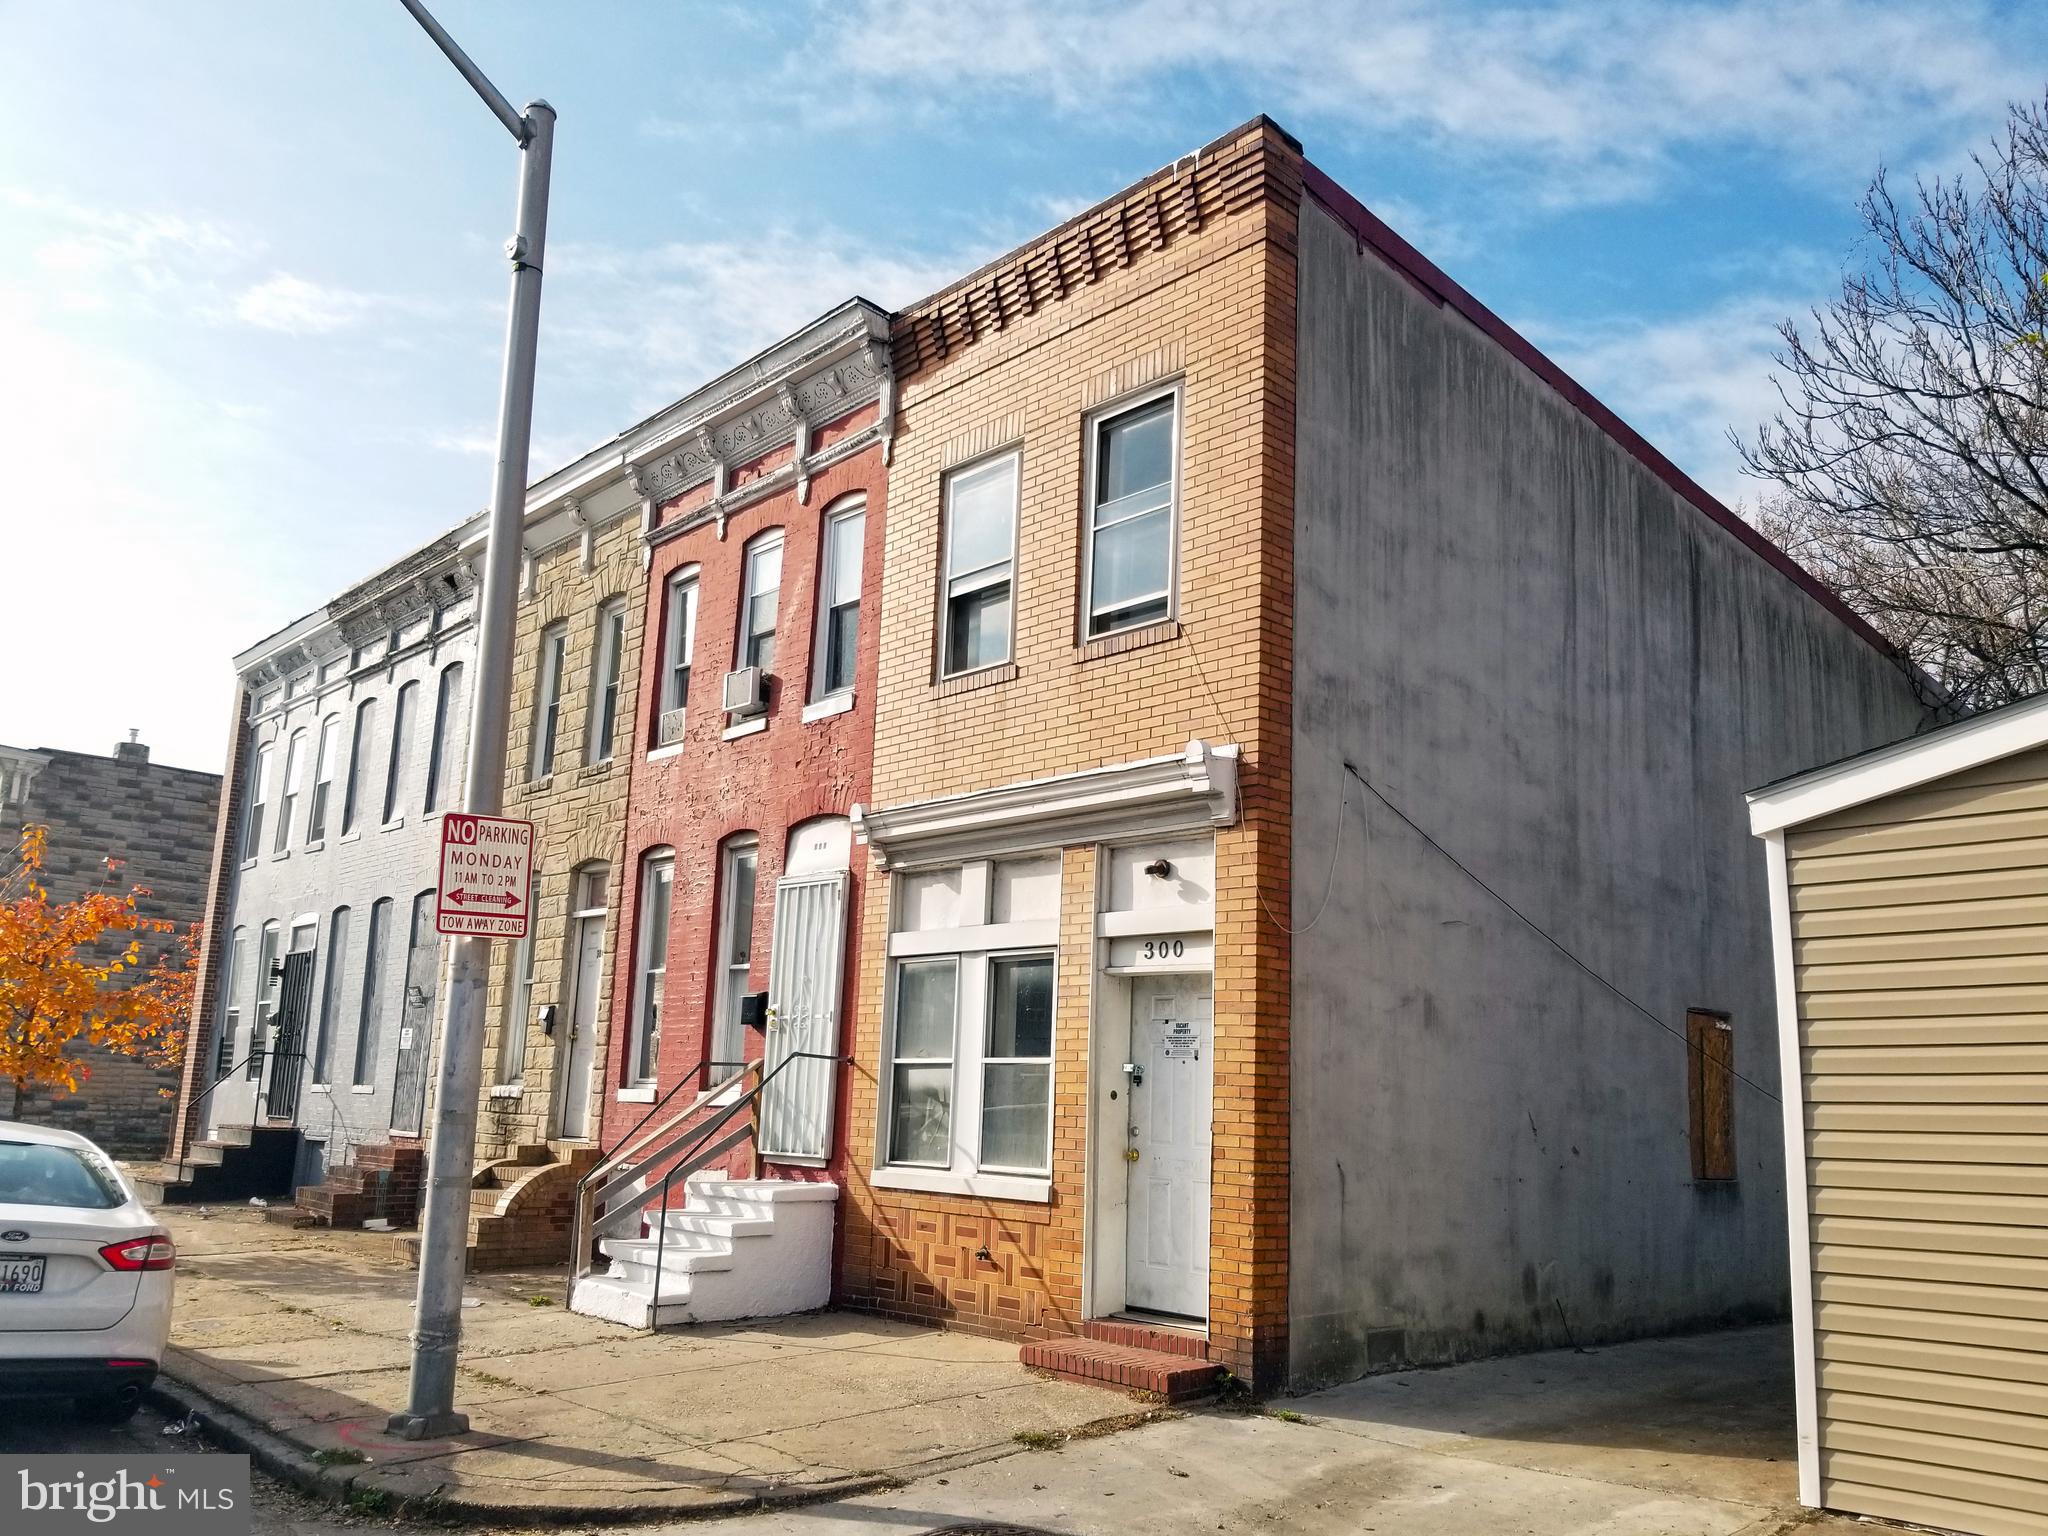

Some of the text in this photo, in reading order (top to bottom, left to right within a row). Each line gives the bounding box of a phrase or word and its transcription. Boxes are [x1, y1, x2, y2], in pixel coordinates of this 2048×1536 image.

[447, 819, 528, 845] NO PARKING
[451, 850, 522, 870] MONDAY
[481, 874, 494, 885] TO
[456, 893, 512, 904] STREET CLEANING
[442, 916, 523, 932] TOW AWAY ZONE
[1144, 940, 1184, 959] 300
[2, 1265, 41, 1284] 1690
[13, 1283, 41, 1292] FORD
